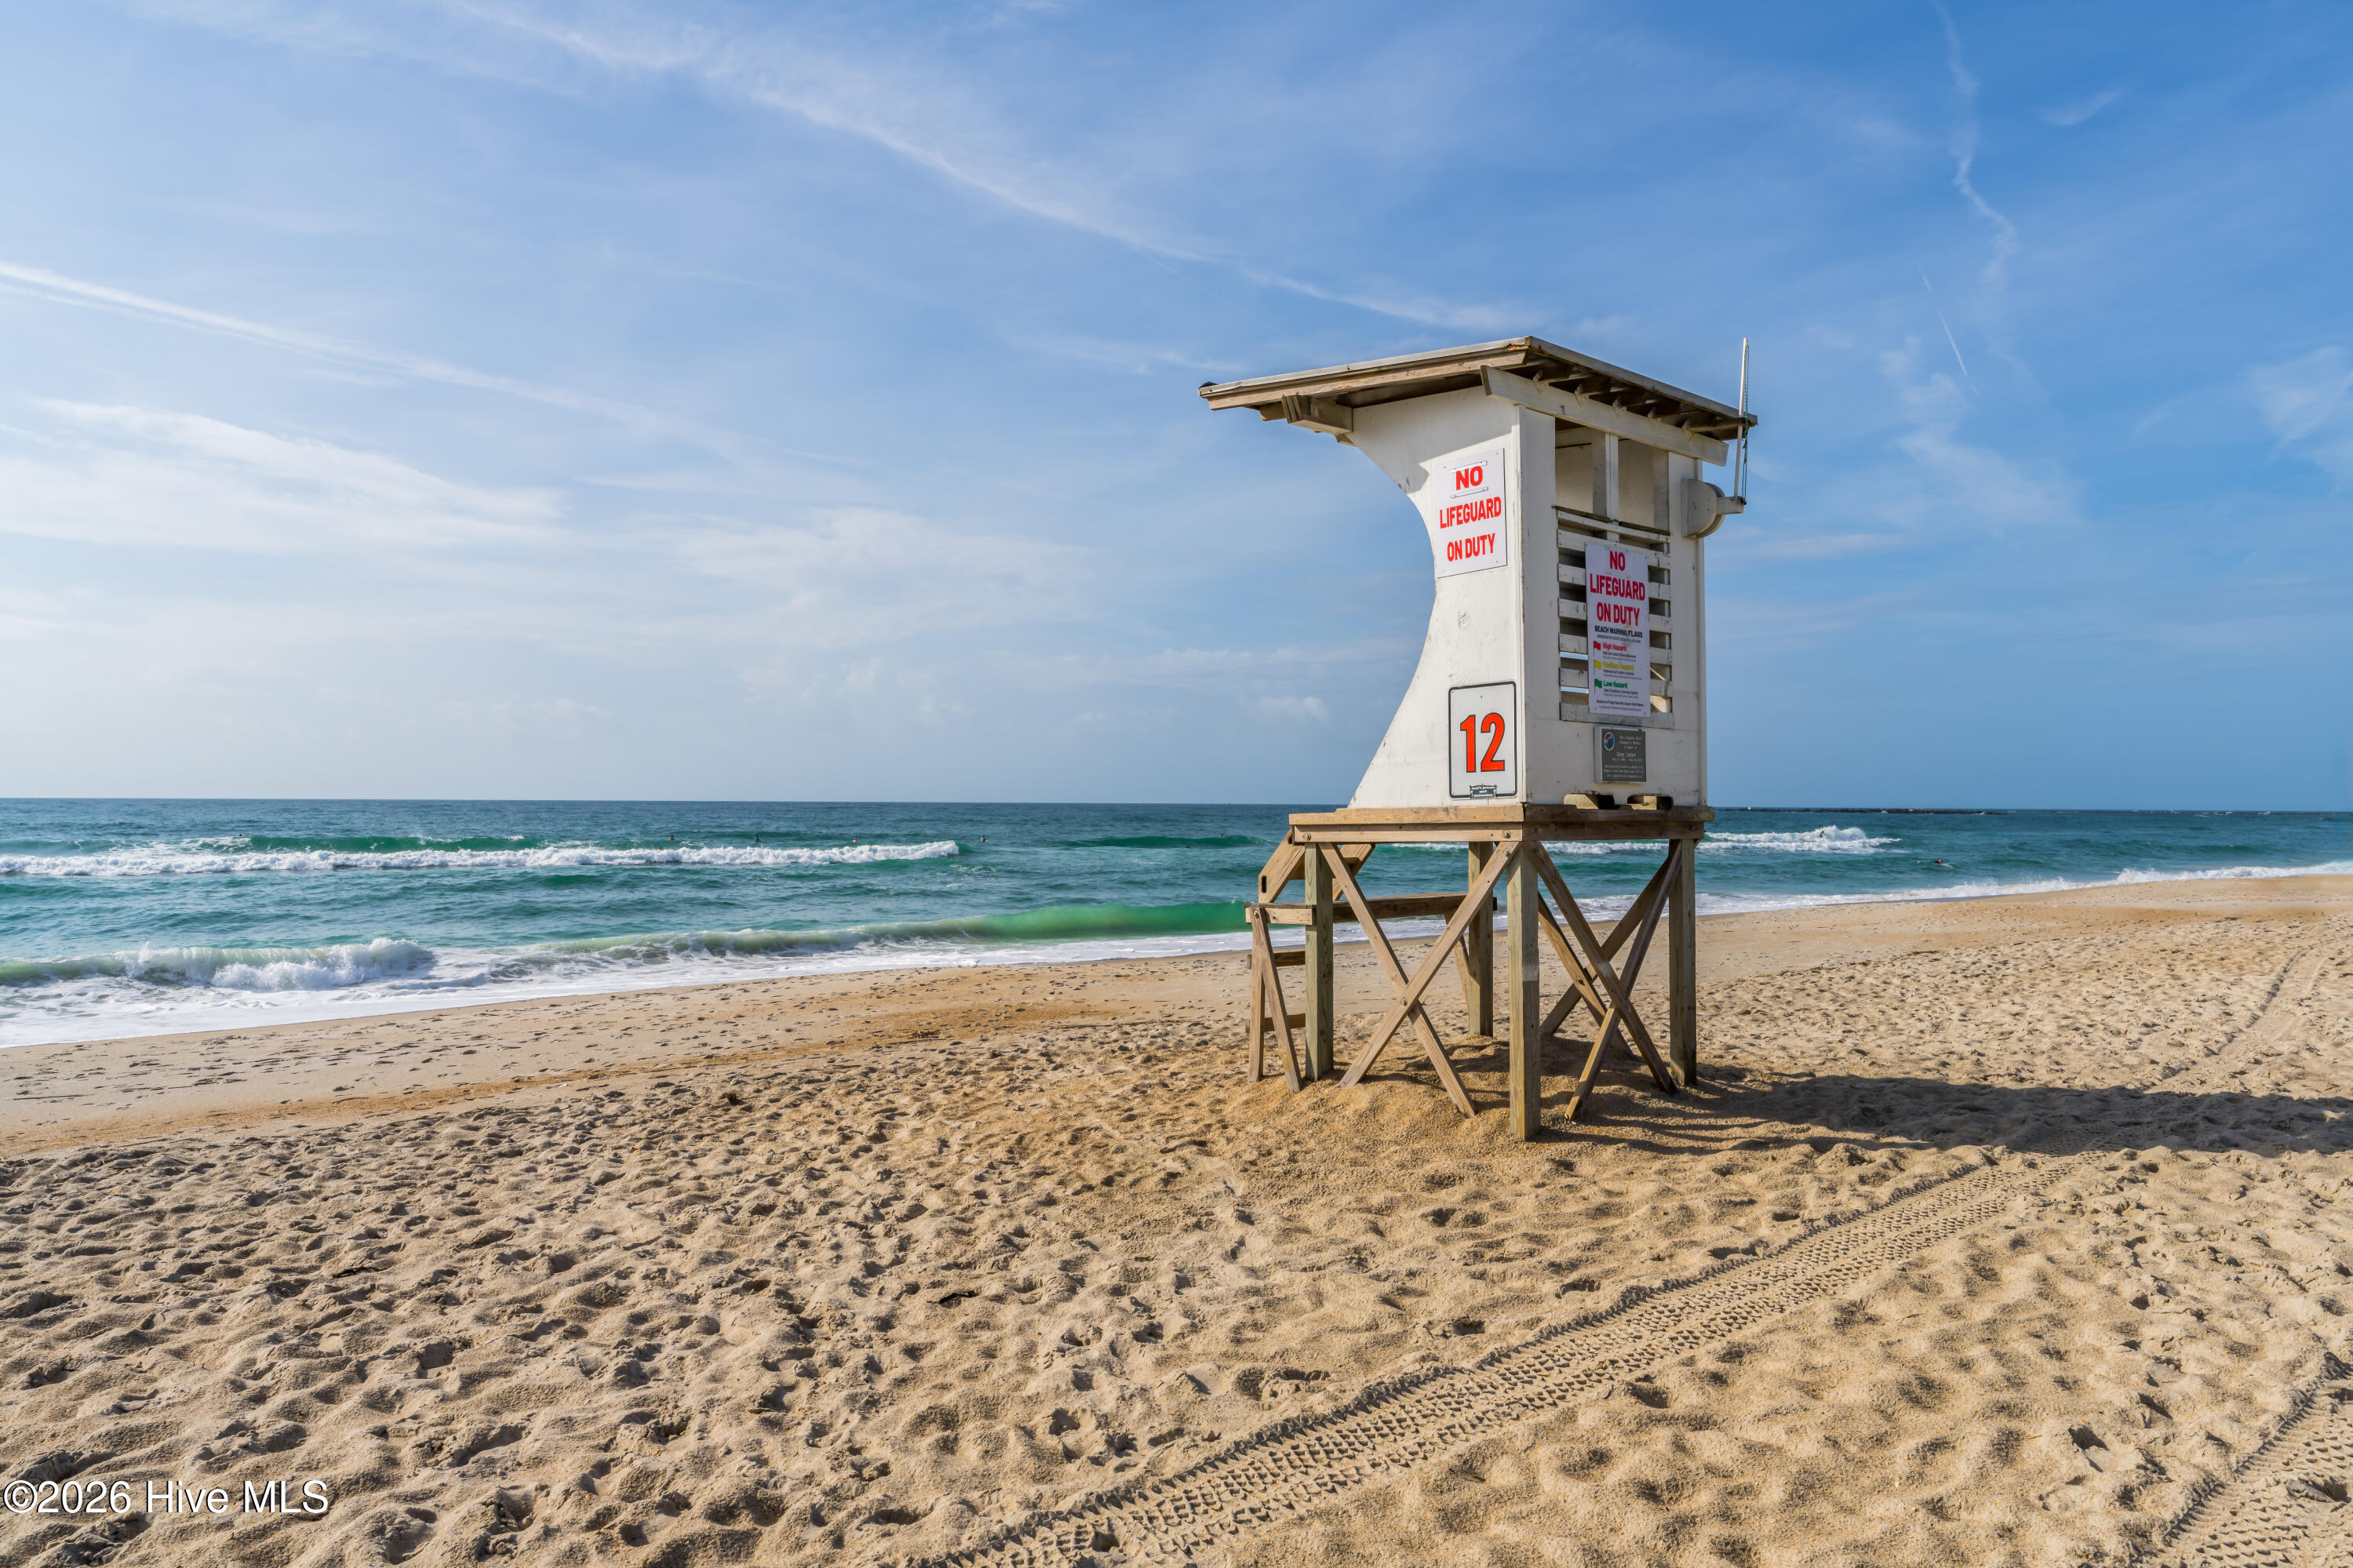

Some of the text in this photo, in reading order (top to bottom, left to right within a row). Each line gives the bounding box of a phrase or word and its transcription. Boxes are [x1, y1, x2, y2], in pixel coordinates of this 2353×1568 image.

[1455, 466, 1483, 490] NO
[1439, 497, 1502, 529] LIFEGUARD
[1447, 533, 1495, 562] ON DUTY
[1609, 550, 1626, 571] NO
[1590, 573, 1645, 602] LIFEGUARD
[1597, 602, 1640, 627] ON DUTY
[1609, 628, 1627, 636] WARNING
[1603, 642, 1612, 651] High
[1460, 712, 1505, 773] 12
